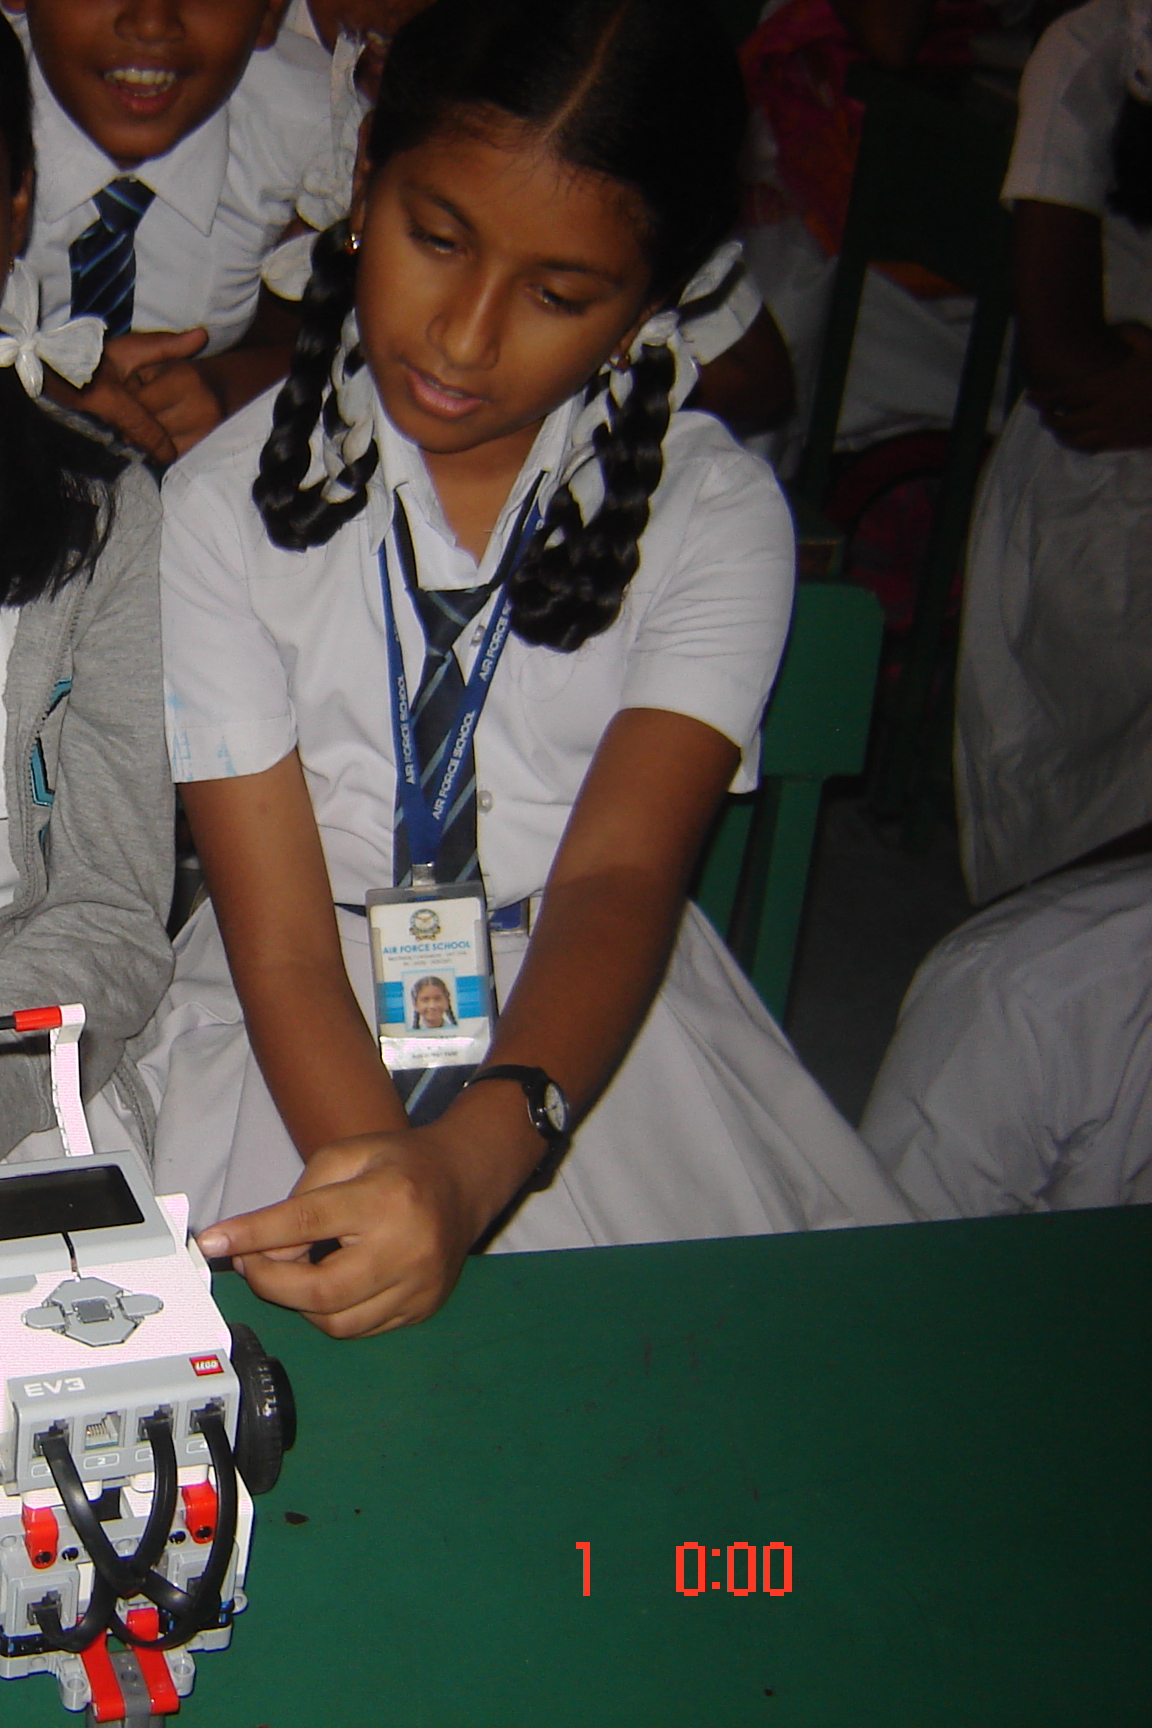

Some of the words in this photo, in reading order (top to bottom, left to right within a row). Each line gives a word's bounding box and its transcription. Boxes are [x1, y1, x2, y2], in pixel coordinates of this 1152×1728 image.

[479, 658, 493, 682] AIR
[486, 616, 508, 658] FORCE
[397, 675, 408, 723] SCHOOL
[400, 723, 413, 763] FORCE
[452, 709, 476, 759] SCHOOL
[404, 762, 416, 785] AIR
[438, 757, 460, 799] FORCE
[432, 798, 446, 820] AIR
[383, 946, 397, 954] AIR
[400, 943, 430, 953] FORCE
[432, 941, 471, 951] SCHOOL
[195, 1360, 218, 1371] LEGO
[23, 1377, 85, 1397] EV3
[97, 1457, 106, 1465] 2
